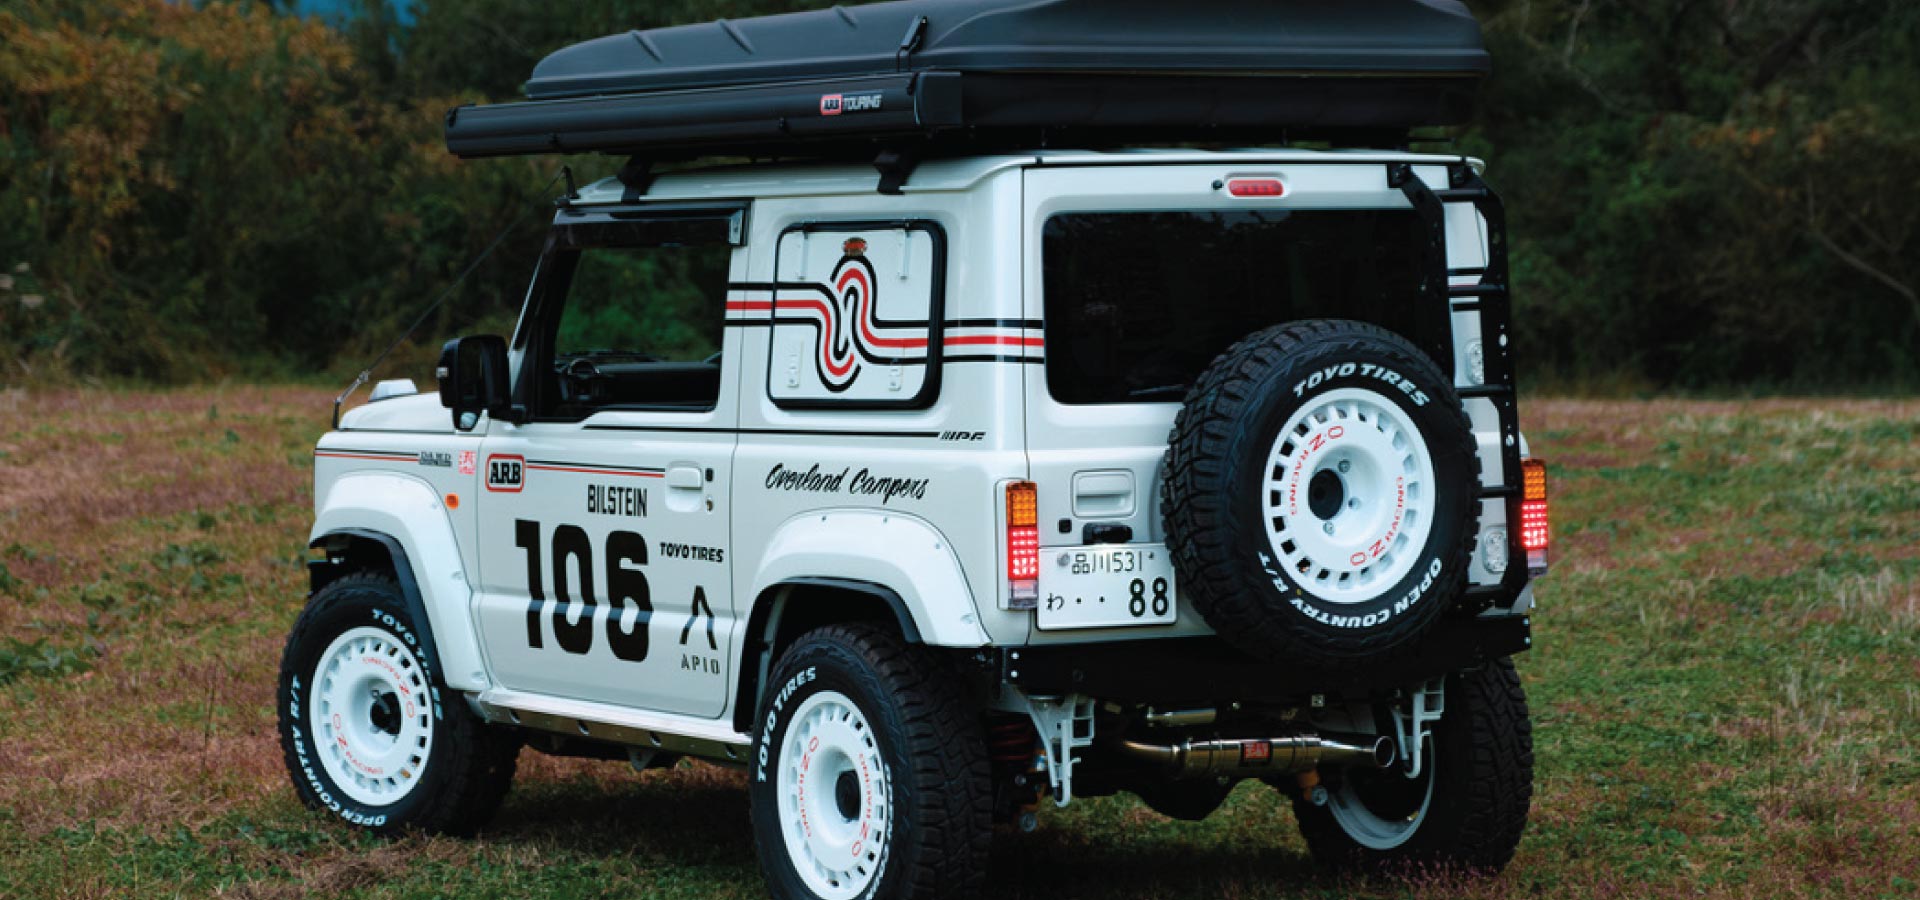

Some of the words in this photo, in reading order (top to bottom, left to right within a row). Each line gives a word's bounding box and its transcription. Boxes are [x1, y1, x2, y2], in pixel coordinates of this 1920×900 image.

[843, 94, 882, 111] TOURING
[1293, 362, 1357, 397] TOYO
[1360, 363, 1430, 406] TIRES
[489, 461, 522, 484] ARB
[765, 462, 850, 493] Overland
[849, 467, 929, 505] Campers
[588, 484, 647, 517] BILSTEIN
[660, 542, 689, 559] TOYO
[691, 545, 724, 563] TIRES
[515, 518, 655, 662] 106
[1258, 551, 1289, 594] R/T
[1393, 557, 1443, 616] OPEN
[1046, 592, 1065, 612] わ
[1129, 576, 1169, 617] 88
[1289, 598, 1392, 628] COUNTRY
[371, 608, 416, 646] TOYO
[681, 653, 721, 675] APIO
[758, 709, 777, 782] TOYO
[774, 666, 817, 711] TIRES
[290, 724, 342, 812] COUNTRY
[340, 808, 388, 827] OPEN
